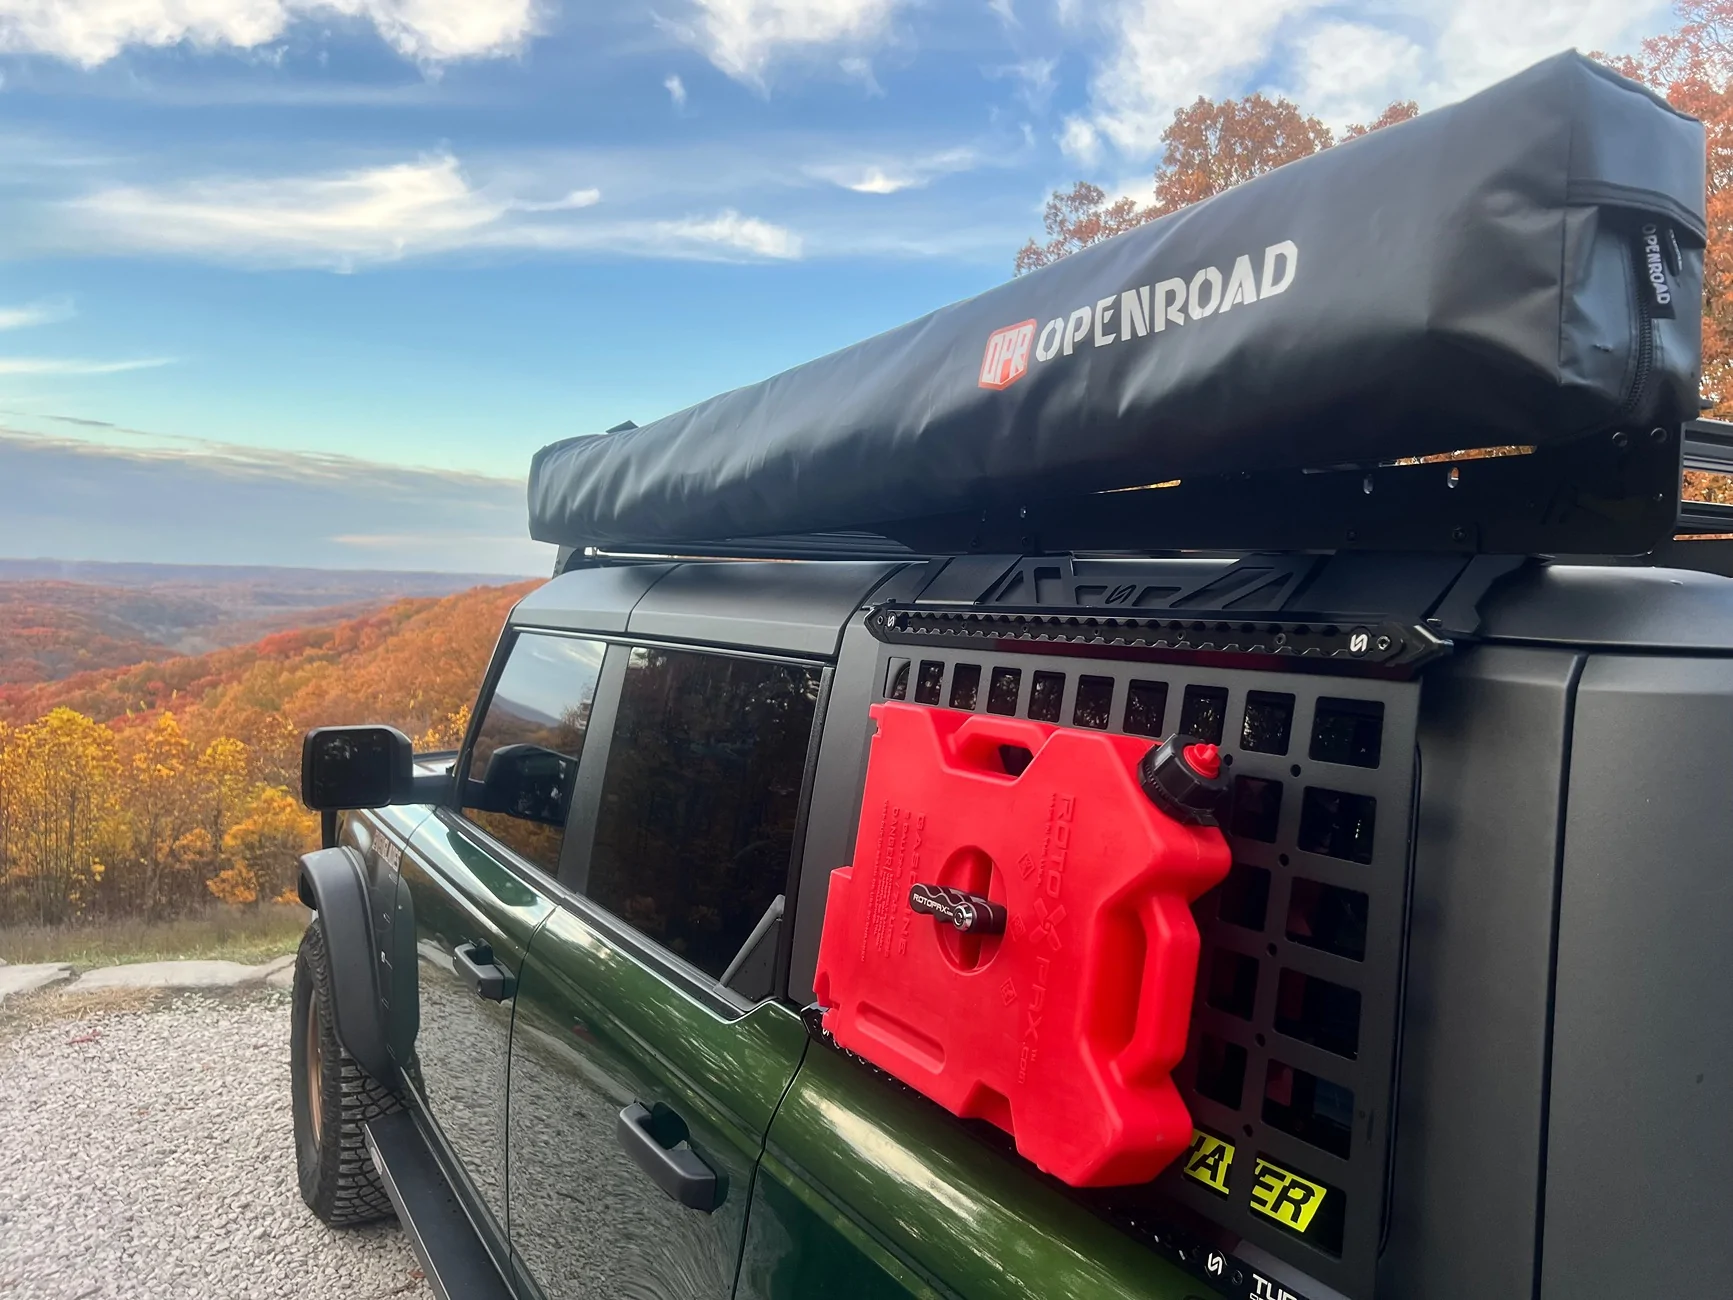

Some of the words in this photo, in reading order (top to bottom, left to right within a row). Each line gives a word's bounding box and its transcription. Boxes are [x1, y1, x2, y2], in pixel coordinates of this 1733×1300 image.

[1036, 240, 1298, 362] OPENROAD
[1642, 224, 1671, 305] OPENROAD
[885, 806, 900, 866] DANGER
[1045, 792, 1077, 898] ROTO
